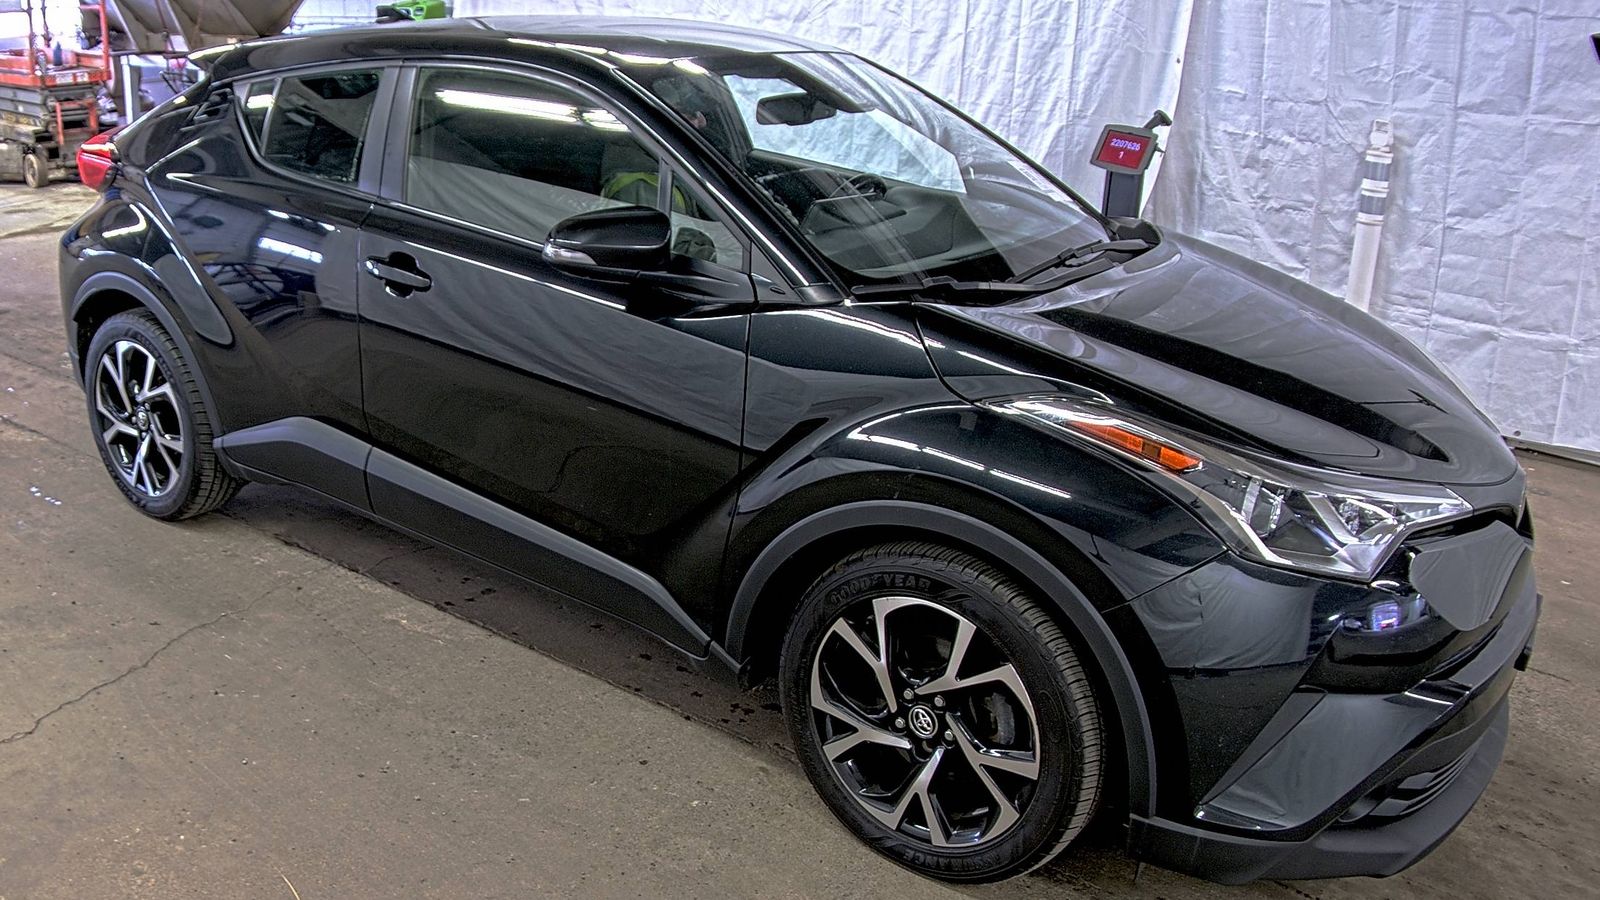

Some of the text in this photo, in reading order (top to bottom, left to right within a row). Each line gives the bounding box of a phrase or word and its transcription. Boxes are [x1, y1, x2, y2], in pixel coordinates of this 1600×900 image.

[1110, 138, 1141, 151] 2207626
[1118, 151, 1124, 159] 1
[830, 574, 931, 605] GOODYEAR
